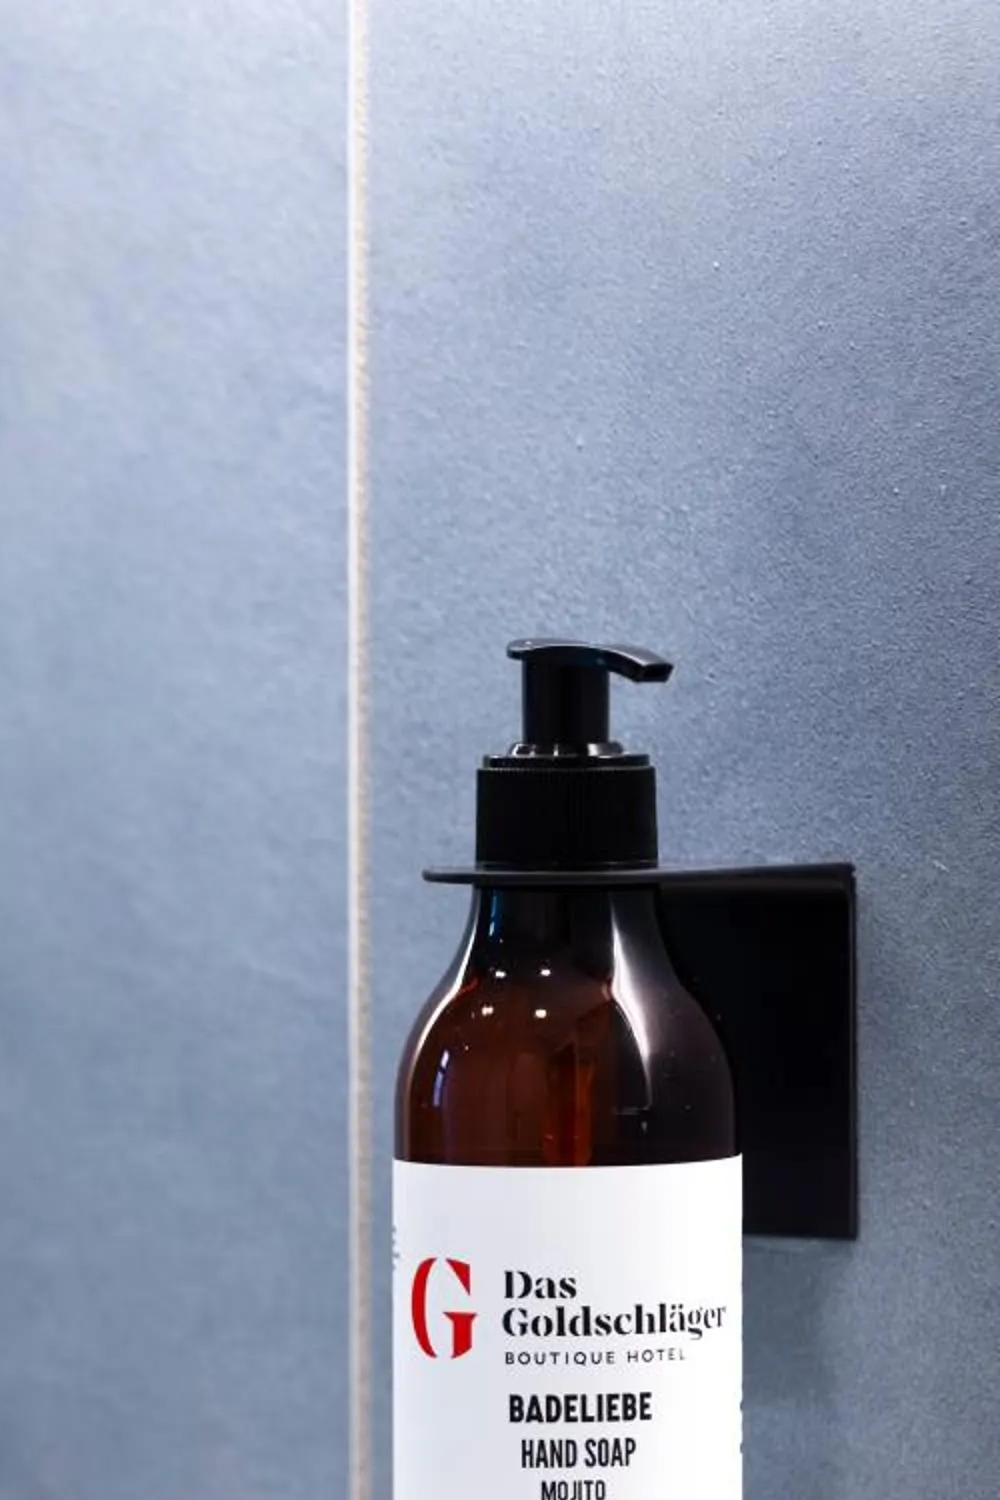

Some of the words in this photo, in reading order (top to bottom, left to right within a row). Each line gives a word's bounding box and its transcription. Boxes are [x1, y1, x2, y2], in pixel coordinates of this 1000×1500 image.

[504, 1270, 577, 1299] Das
[411, 1257, 477, 1359] G
[502, 1304, 727, 1341] Goldschläger
[505, 1351, 615, 1366] BOUTIQUE
[627, 1348, 687, 1363] HOTEL
[509, 1392, 652, 1424] BADELIEBE
[521, 1439, 578, 1469] HAND
[584, 1437, 637, 1468] SOAP
